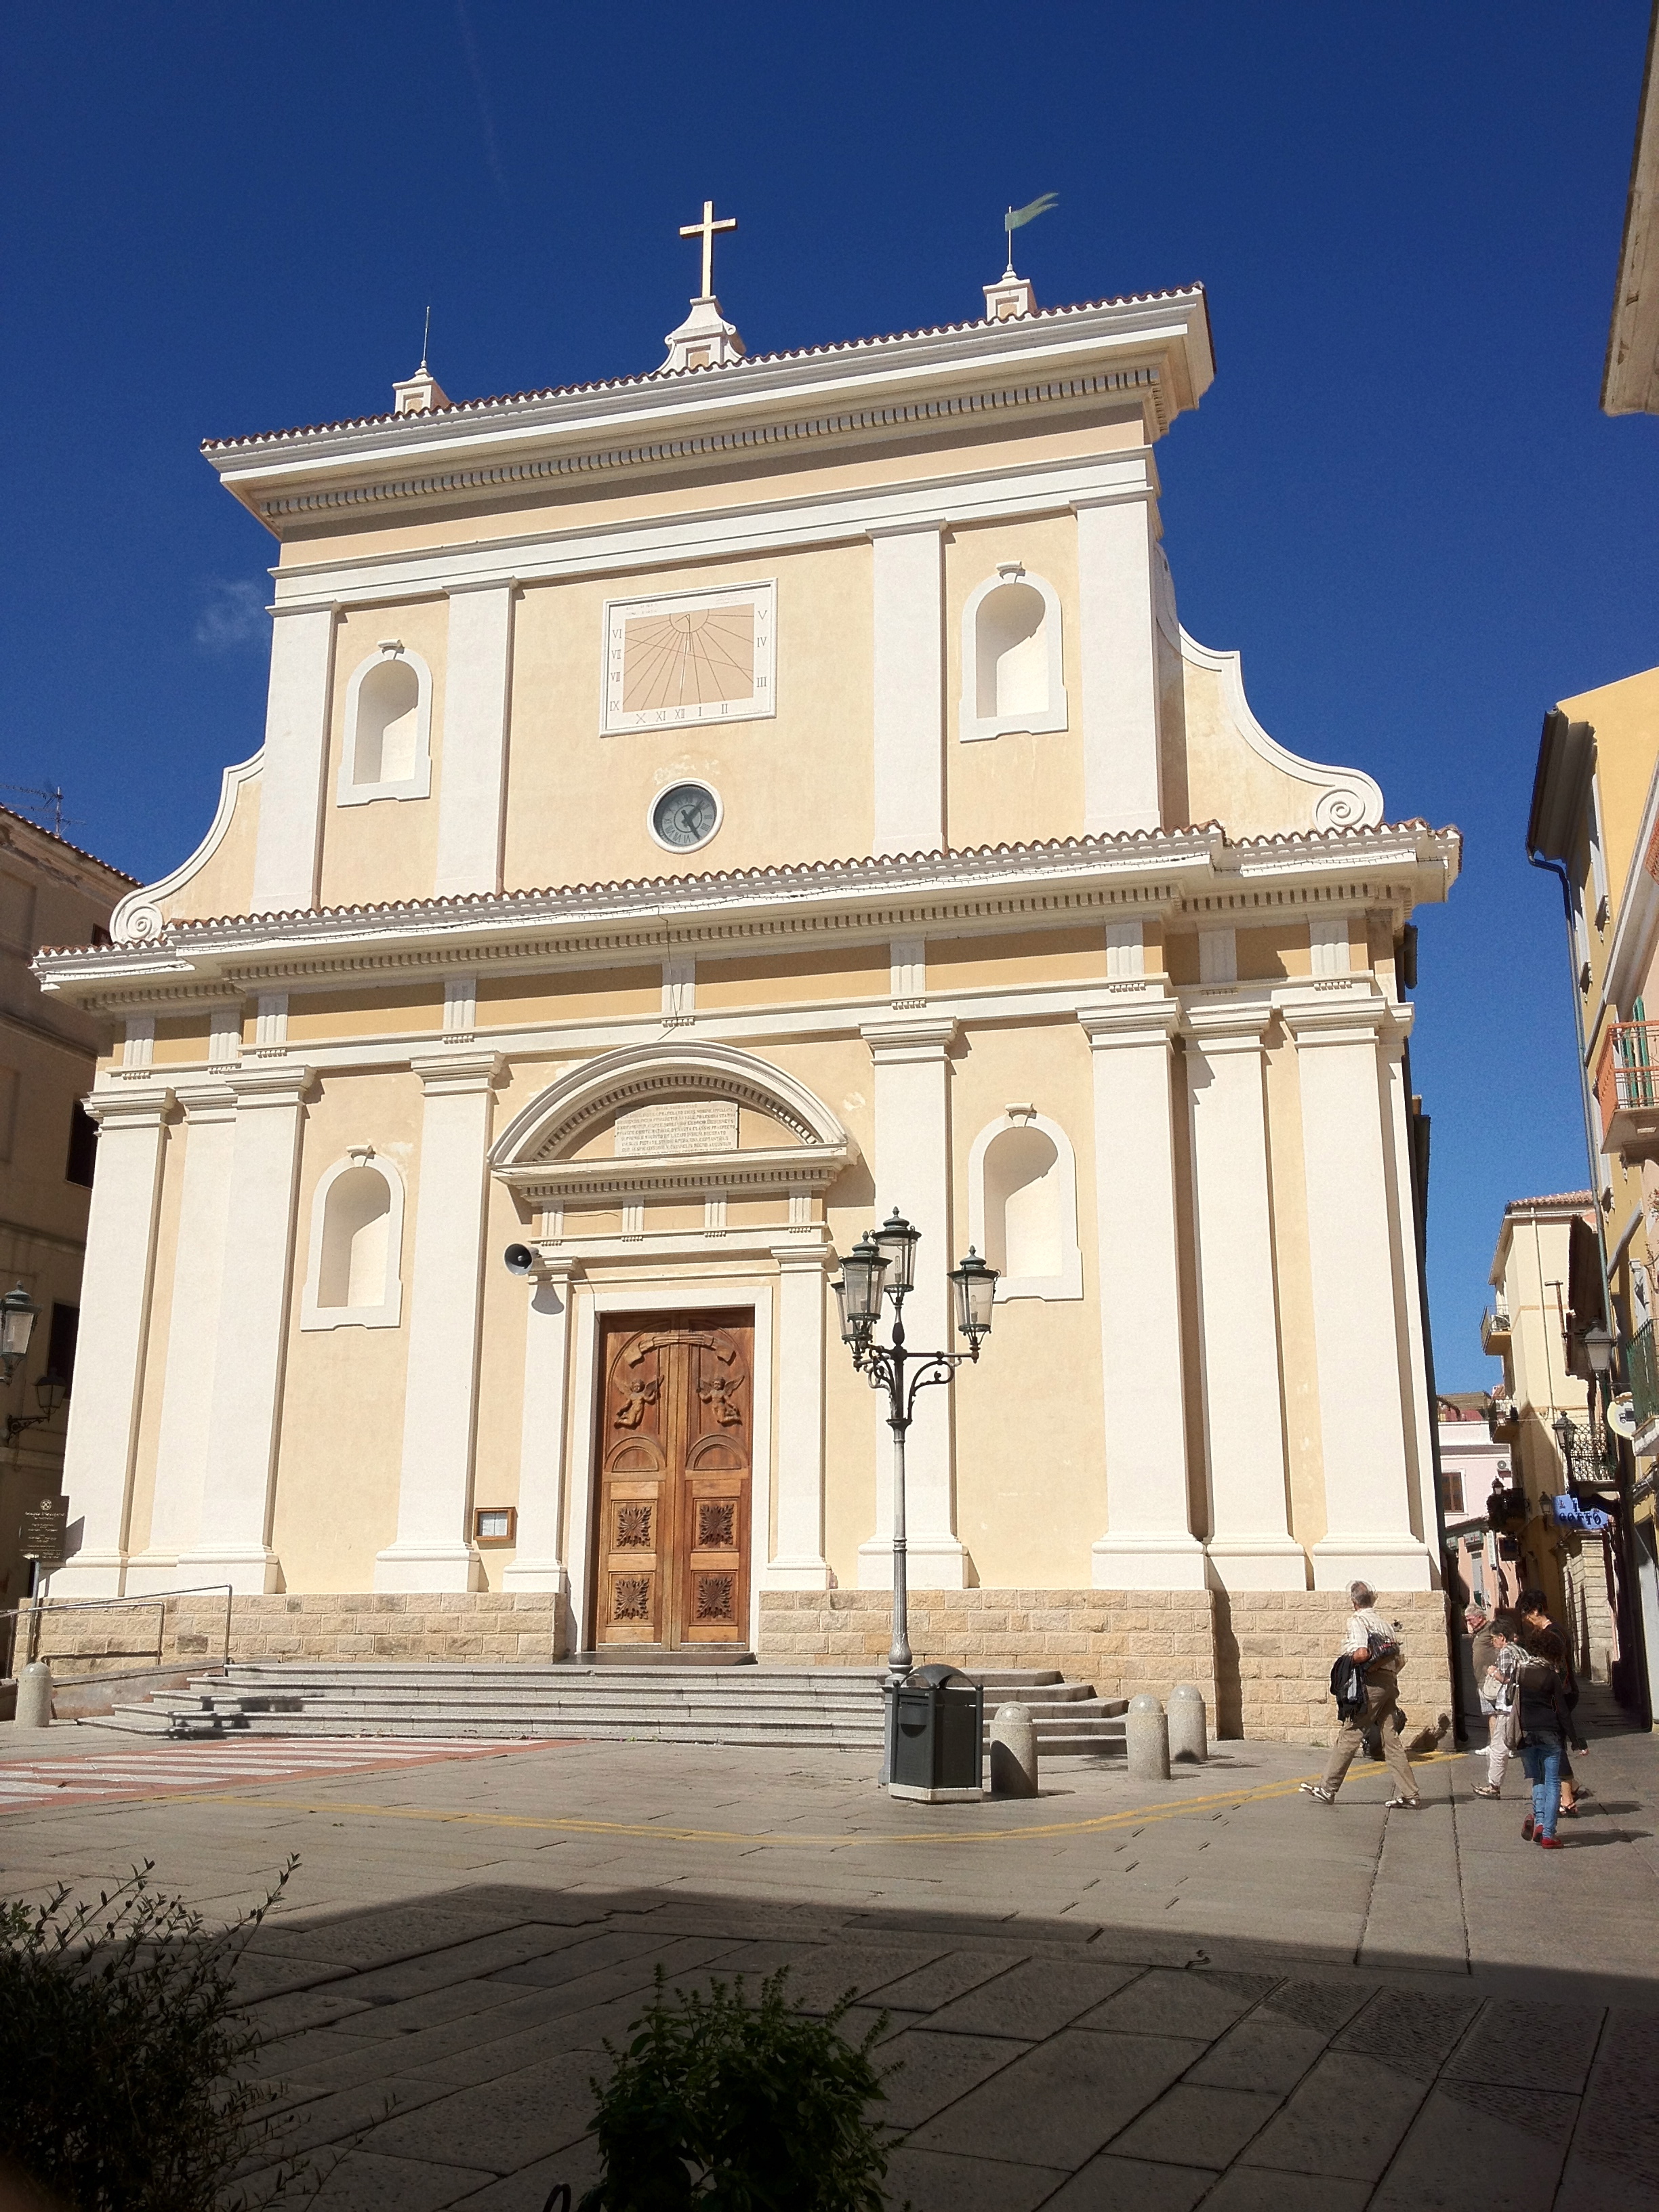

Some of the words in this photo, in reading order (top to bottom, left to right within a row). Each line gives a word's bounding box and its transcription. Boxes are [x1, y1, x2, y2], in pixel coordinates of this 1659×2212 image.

[613, 629, 621, 638] VI
[757, 637, 767, 647] IV
[756, 676, 766, 687] III
[610, 700, 619, 711] IX
[721, 703, 728, 714] II
[656, 711, 666, 722] XI
[698, 707, 702, 716] I
[636, 713, 646, 724] X
[1559, 1513, 1601, 1525] GOTTO
